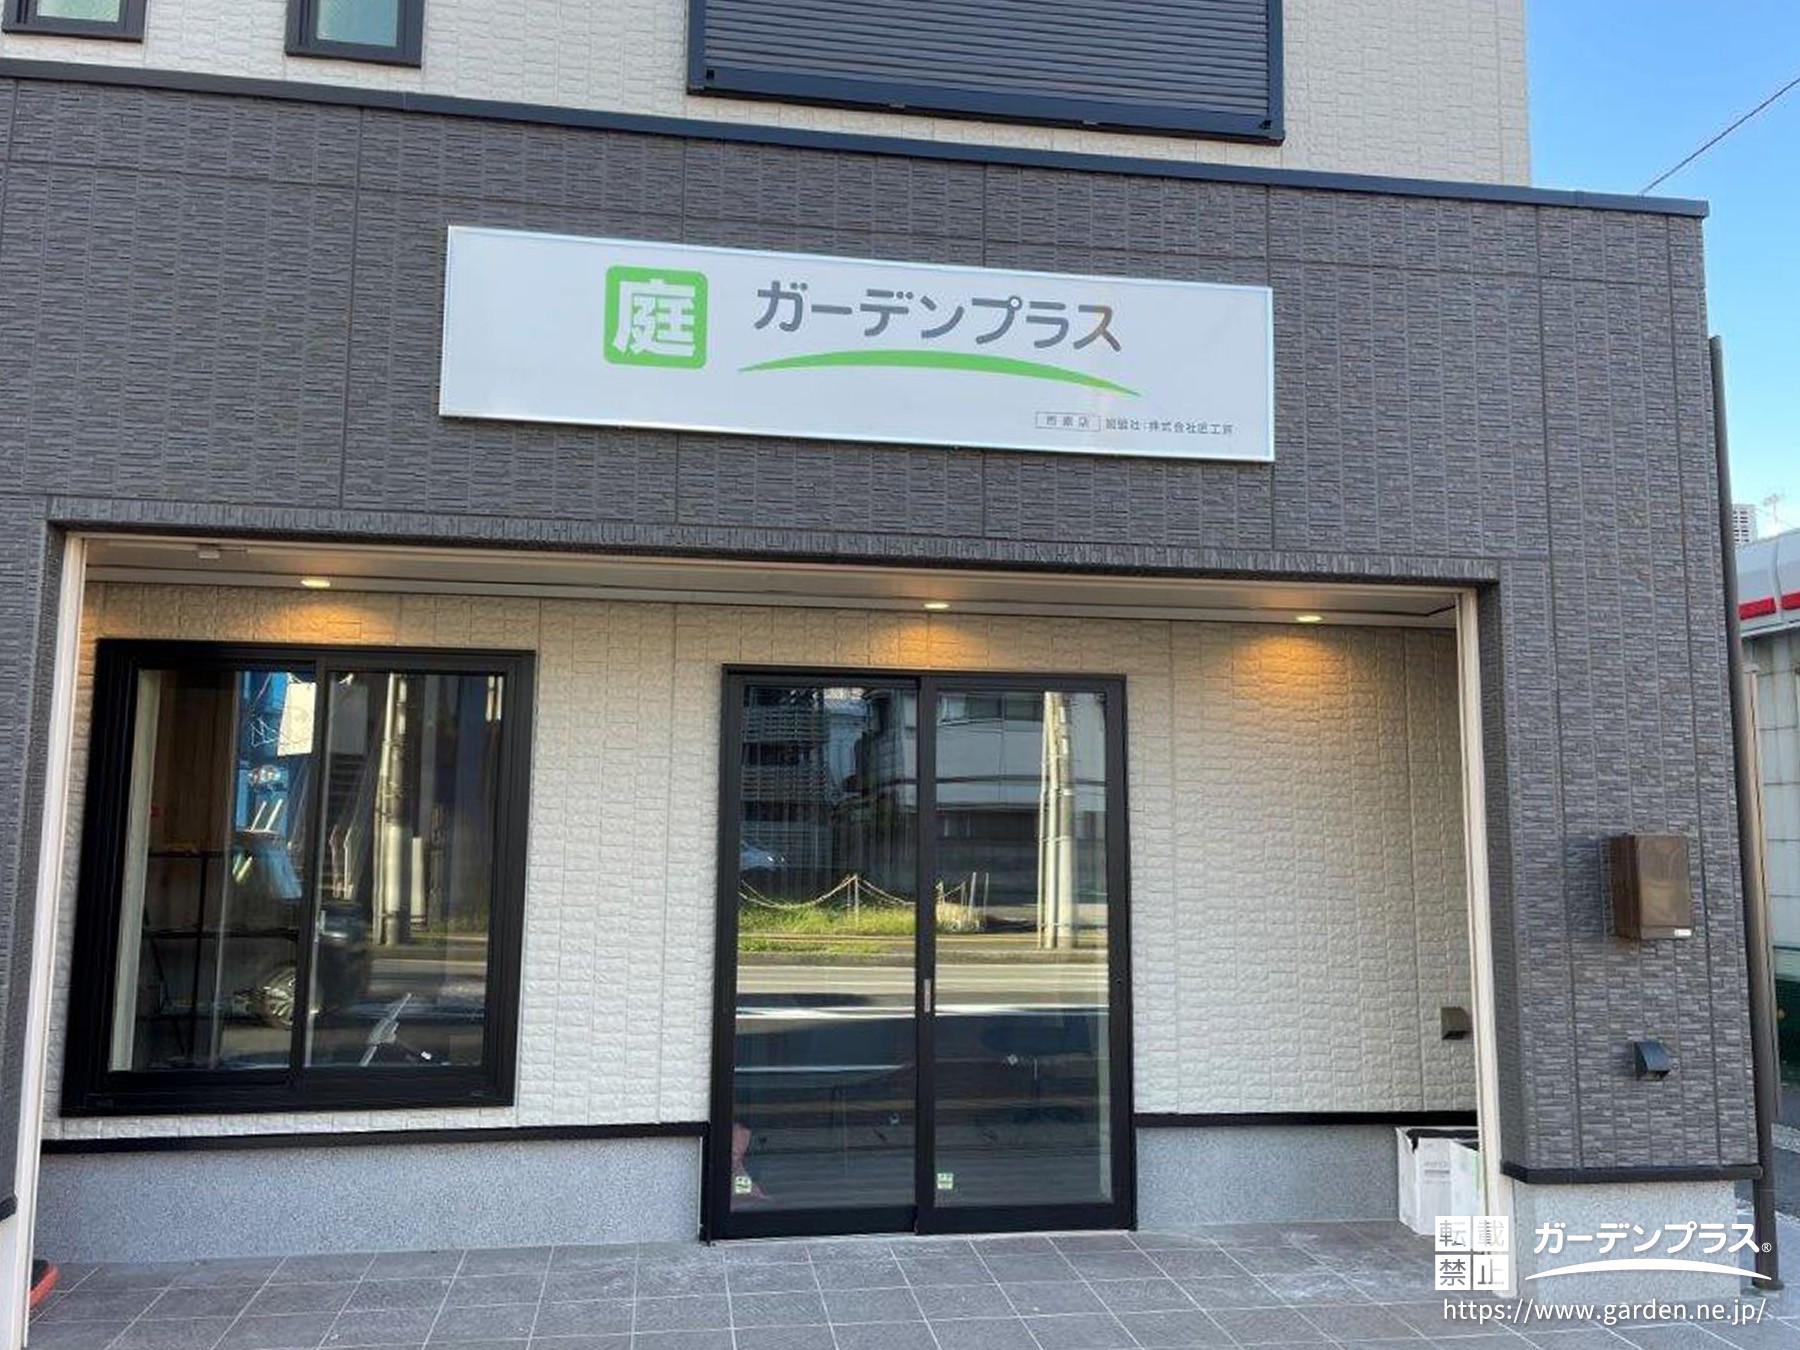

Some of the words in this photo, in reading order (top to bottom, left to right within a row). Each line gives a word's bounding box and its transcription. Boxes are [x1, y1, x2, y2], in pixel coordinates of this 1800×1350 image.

[613, 277, 697, 358] 庭
[754, 279, 1122, 352] ガーデンプラス
